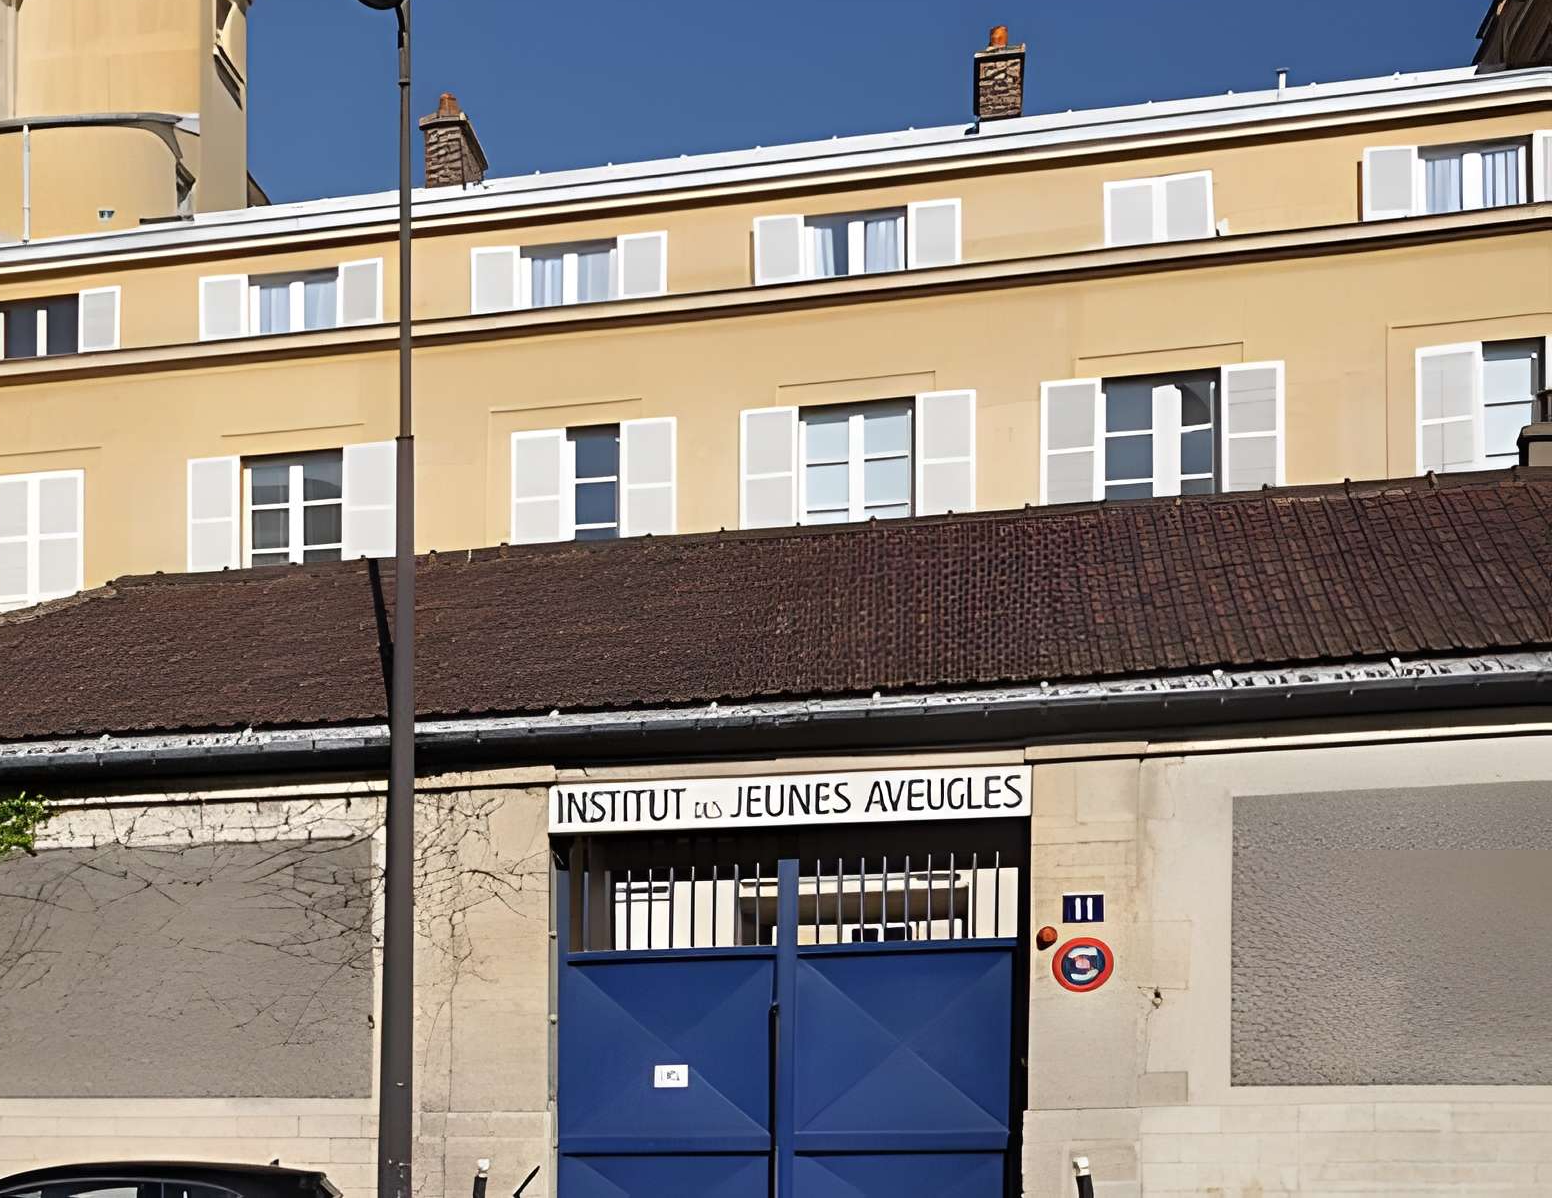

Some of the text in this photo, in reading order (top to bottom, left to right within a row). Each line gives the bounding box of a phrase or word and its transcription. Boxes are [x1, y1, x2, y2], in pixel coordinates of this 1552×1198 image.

[557, 787, 687, 824] INSTITUT
[730, 782, 851, 818] JEUNES
[864, 774, 1023, 813] AVEUGLES
[1074, 897, 1094, 921] 11
